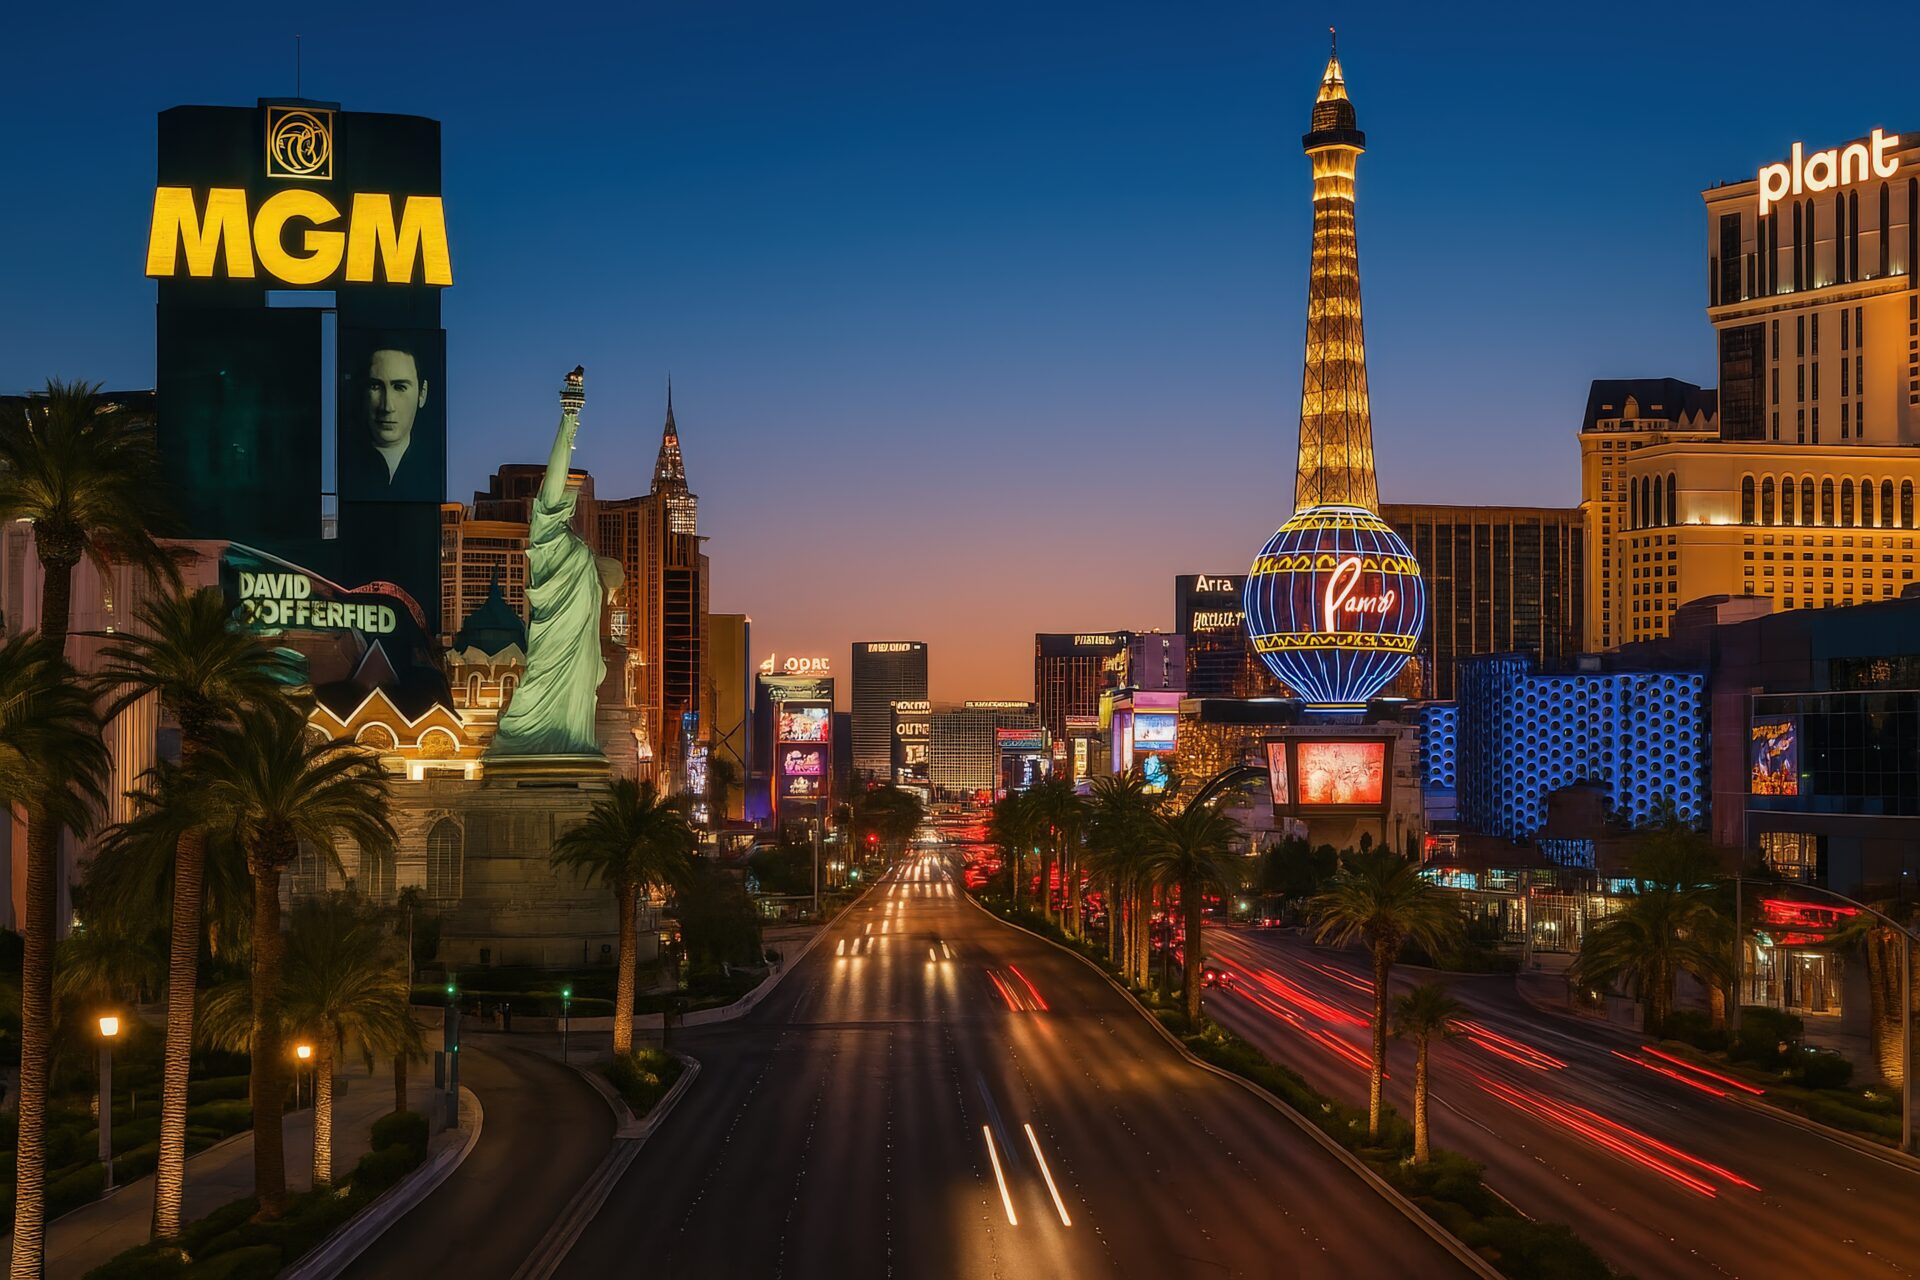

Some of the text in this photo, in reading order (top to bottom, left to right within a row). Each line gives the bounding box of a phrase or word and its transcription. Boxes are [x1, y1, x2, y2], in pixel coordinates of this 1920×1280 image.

[1759, 128, 1899, 216] plant
[145, 187, 453, 285] MGM
[239, 572, 311, 599] DAVID
